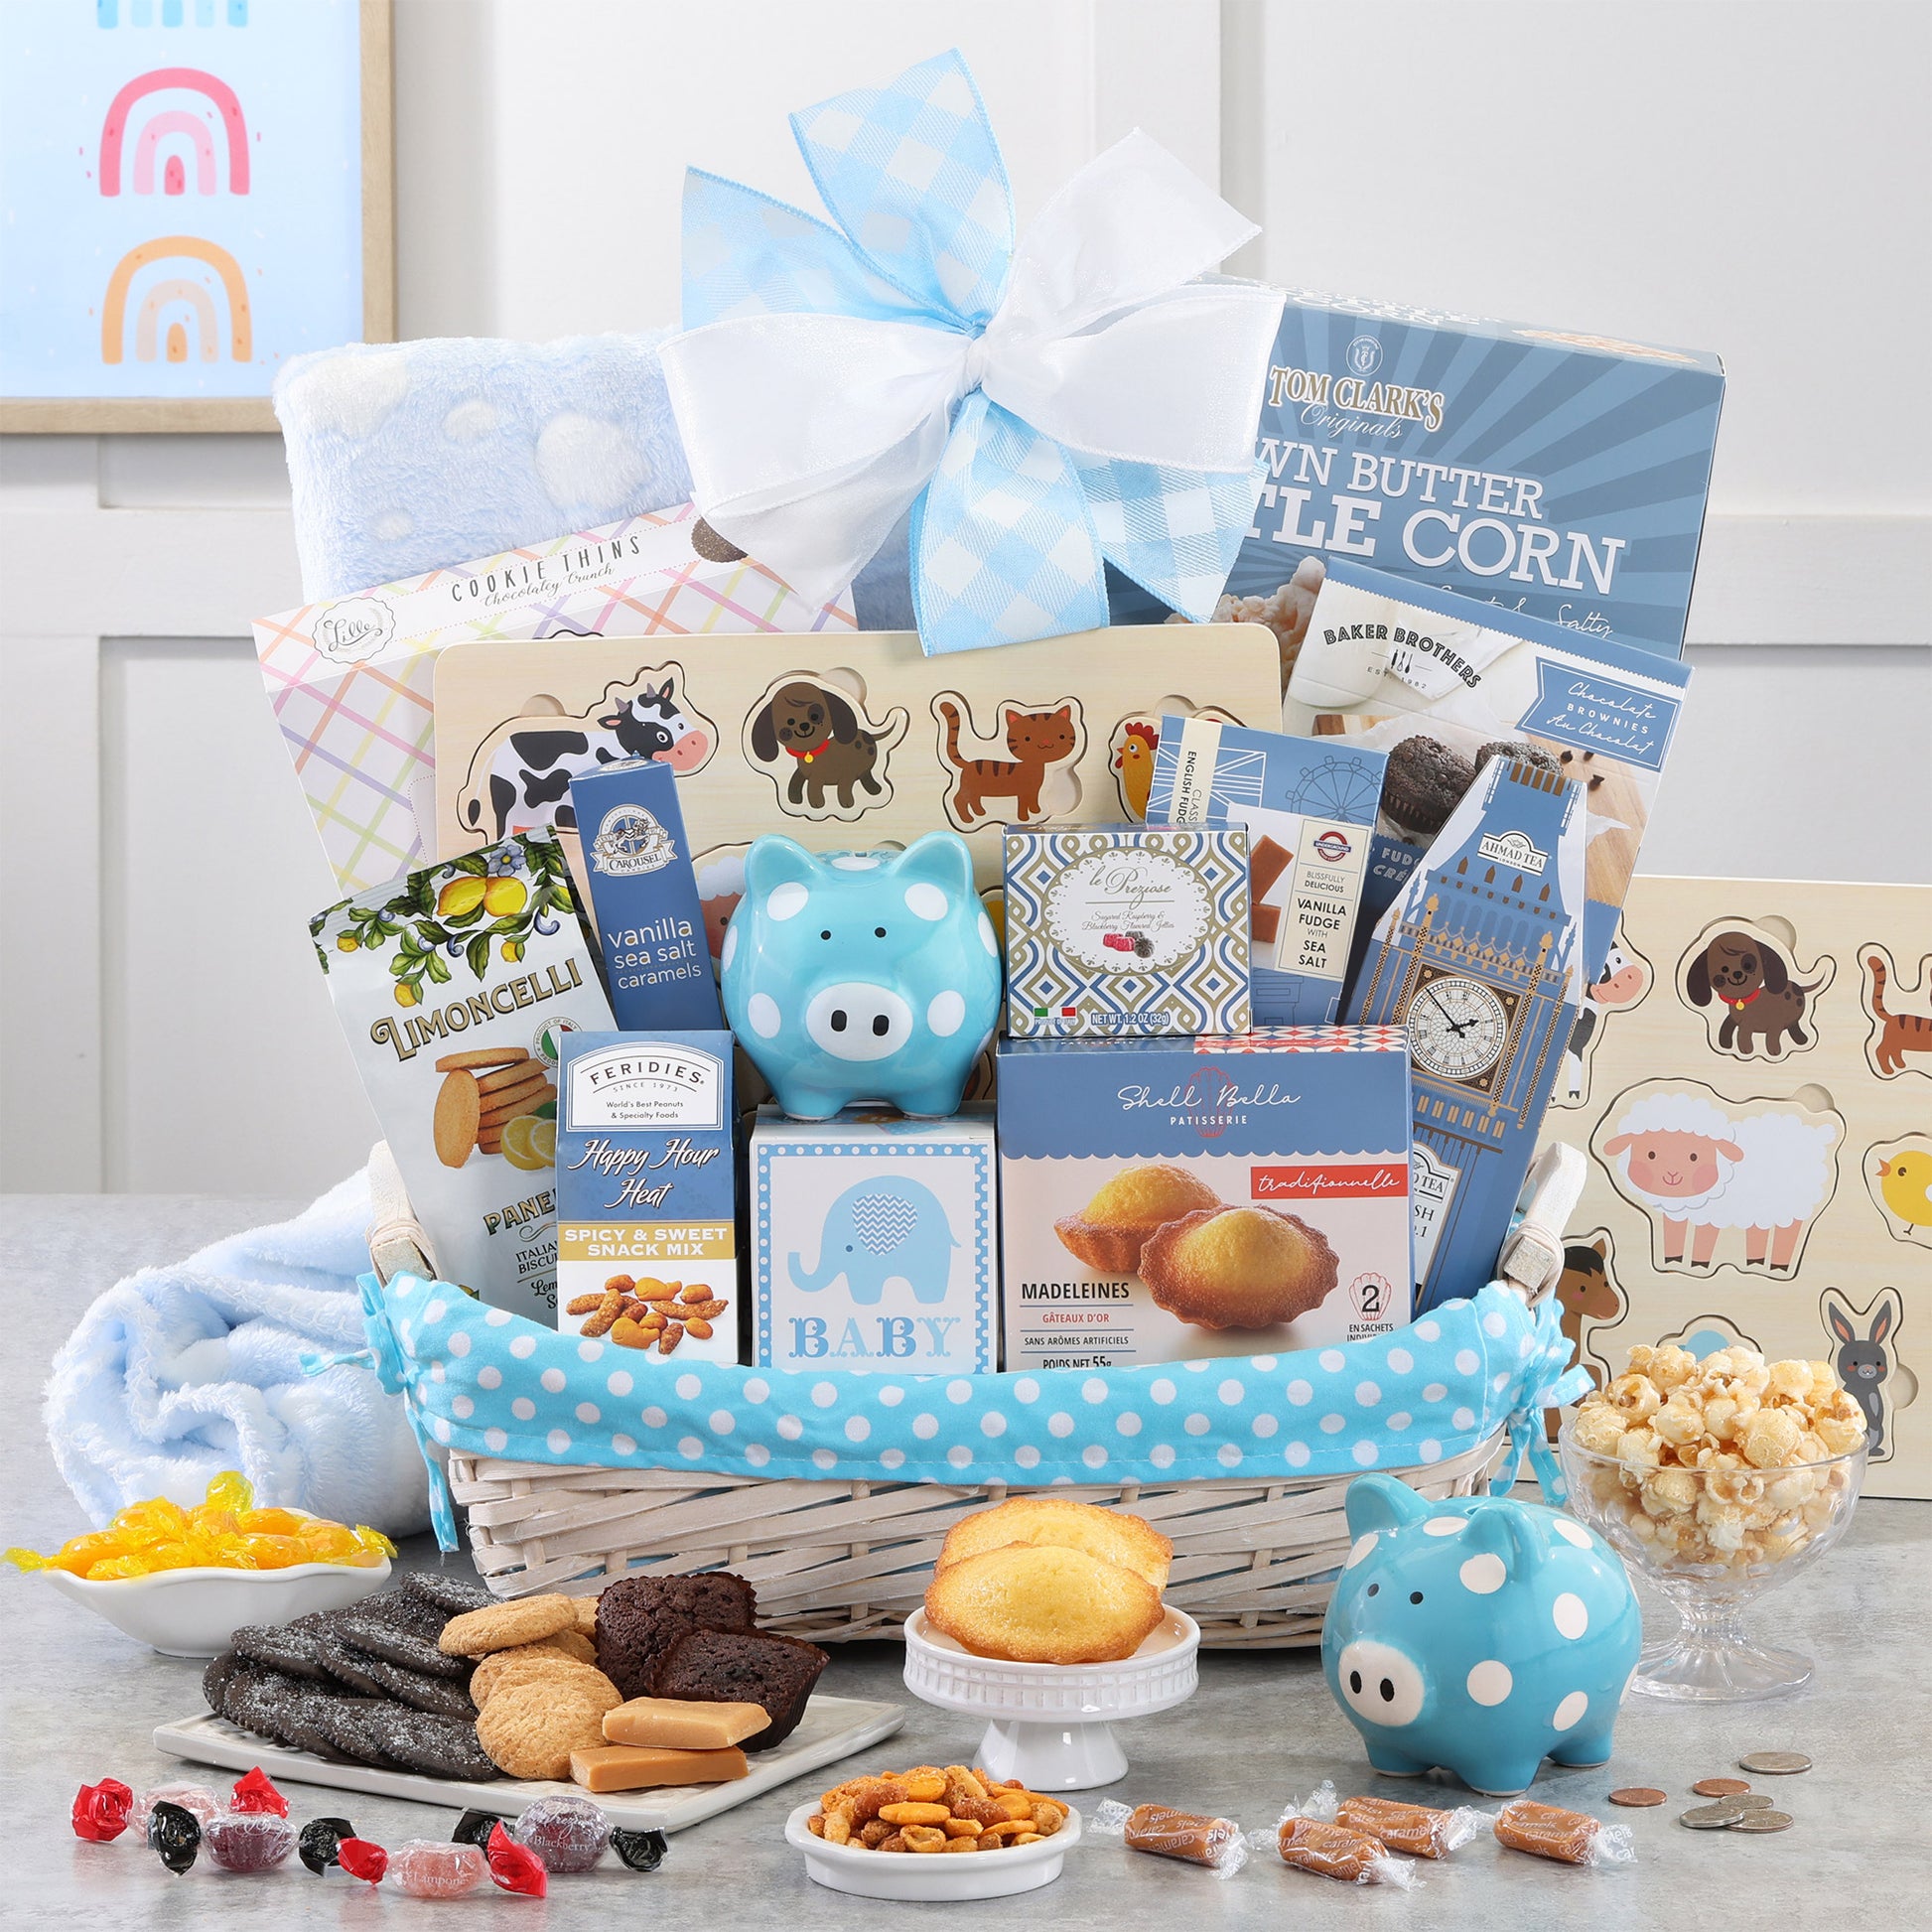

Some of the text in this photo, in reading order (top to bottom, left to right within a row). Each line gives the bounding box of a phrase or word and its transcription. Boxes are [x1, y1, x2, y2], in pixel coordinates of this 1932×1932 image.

[1269, 365, 1444, 432] TOM CLARK'S
[1301, 402, 1403, 439] Originals
[1254, 437, 1544, 519] WN BUTTER
[1403, 508, 1626, 595] CORN
[452, 535, 640, 603] COOKIE THINS
[482, 563, 616, 607] Chocolatey Crunch
[1555, 604, 1613, 638] Salty
[324, 617, 383, 652] Lille
[1323, 624, 1482, 688] BAKER BROTHERS
[1568, 681, 1657, 719] Chocolate
[1567, 703, 1648, 735] BROWNIES
[1546, 714, 1655, 755] Au Chocolat
[1176, 751, 1197, 824] ENGLISH FUDG
[1187, 788, 1202, 823] CLASS
[609, 853, 662, 872] CAROUSEL
[1381, 847, 1421, 870] FUD
[1481, 841, 1542, 868] AHMAD TEA
[1089, 865, 1173, 910] le Preziose
[1304, 880, 1344, 894] DELICIOUS
[1307, 871, 1345, 884] BLISSFULLY
[1373, 864, 1410, 885] CRÉ
[1298, 897, 1346, 916] VANILLA
[607, 916, 693, 949] vanilla
[1299, 913, 1340, 930] FUDGE
[1308, 928, 1328, 938] WITH
[615, 940, 696, 970] sea salt
[1304, 939, 1326, 953] SEA
[1299, 954, 1327, 969] SALT
[618, 963, 702, 989] caramels
[370, 958, 583, 1061] LIMONCELLI
[1092, 1012, 1170, 1026] NET WT. 1.2 OZ (32g)
[590, 1061, 701, 1086] FERIDIES
[613, 1082, 678, 1092] SINCE 1973
[1117, 1083, 1301, 1109] Shell Bella
[1170, 1115, 1248, 1126] PATISSERIE
[567, 1138, 720, 1176] Happy Hour
[604, 1177, 673, 1209] Heat
[1258, 1168, 1401, 1195] traditionnelle
[1422, 1175, 1444, 1193] TEA
[483, 1187, 556, 1236] PANE
[565, 1227, 728, 1241] SPICY & SWEET
[515, 1240, 557, 1262] ITALIA
[587, 1243, 705, 1257] SNACK MIX
[1022, 1282, 1130, 1300] MADELEINES
[1361, 1284, 1380, 1312] 2
[1042, 1311, 1110, 1323] GÂTEAUX D'OR
[1349, 1322, 1394, 1332] EN SACHETS
[788, 1316, 961, 1358] BABY
[1025, 1335, 1129, 1346] SANS ARÔMES ARTIFICIELS
[1042, 1358, 1070, 1369] POIDS
[533, 1835, 590, 1852] Blackberry
